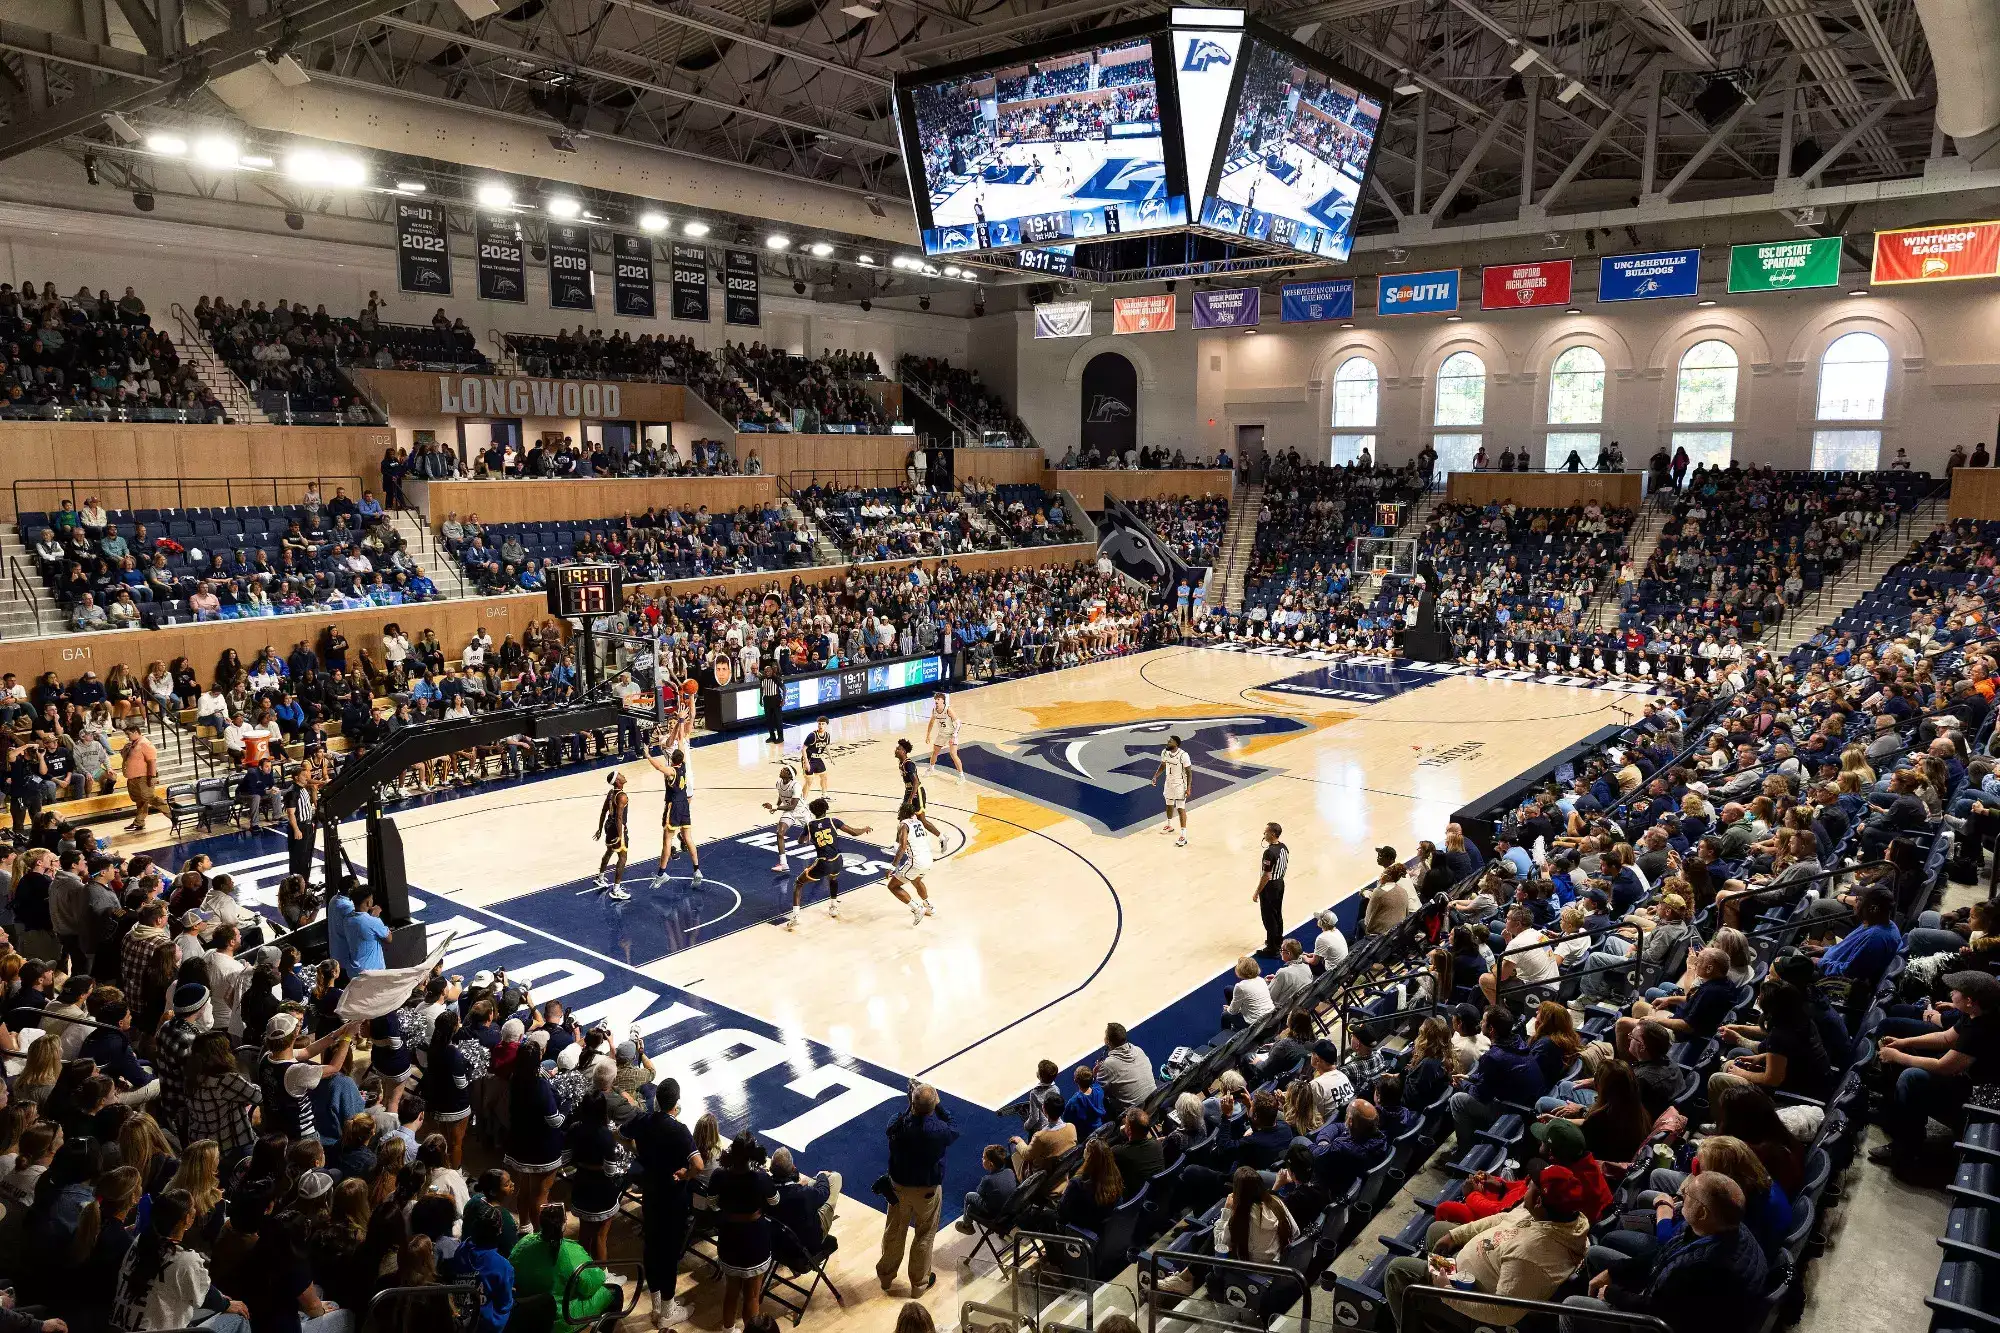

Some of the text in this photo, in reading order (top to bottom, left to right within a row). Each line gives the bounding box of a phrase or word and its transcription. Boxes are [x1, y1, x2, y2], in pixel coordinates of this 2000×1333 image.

[1027, 215, 1064, 233] 19:11
[1082, 212, 1095, 231] 2
[1254, 215, 1264, 233] 2
[1274, 218, 1296, 235] 19:11
[998, 224, 1009, 242] 2
[1045, 230, 1059, 239] HALF
[1304, 228, 1311, 246] 2
[1903, 231, 1976, 247] WINTHROP
[403, 234, 445, 252] 2022
[627, 240, 638, 248] CBI
[1912, 243, 1963, 255] EAGLES
[481, 245, 520, 262] 2022
[1758, 244, 1812, 259] USC UPSTATE
[554, 255, 587, 271] 2019
[1020, 250, 1050, 270] 19:11
[1614, 256, 1687, 270] UNC ASHEVILLE
[1762, 256, 1805, 270] SPARTANS
[618, 264, 649, 280] 2021
[1059, 264, 1066, 273] 17
[1513, 267, 1541, 279] RADFORD
[1625, 266, 1674, 277] BULLDOGS
[674, 270, 705, 285] 2022
[1505, 277, 1547, 290] HIGHLANDERS
[728, 278, 757, 292] 2022
[1283, 285, 1353, 297] PRESBYTERIAN COLLEGE
[1208, 293, 1244, 303] HIGH POINT
[1301, 293, 1333, 302] BLUE HOSE
[1397, 287, 1413, 299] BIG
[1209, 301, 1242, 310] PANTHERS
[440, 376, 621, 418] LONGWOOD
[371, 435, 391, 445] 102
[1588, 479, 1603, 487] 108
[1384, 513, 1395, 525] 17
[568, 568, 609, 584] 19:11
[580, 587, 604, 612] 17
[486, 607, 508, 617] GA2
[62, 647, 92, 661] GA1
[843, 672, 866, 685] 19:11
[815, 828, 834, 848] 25
